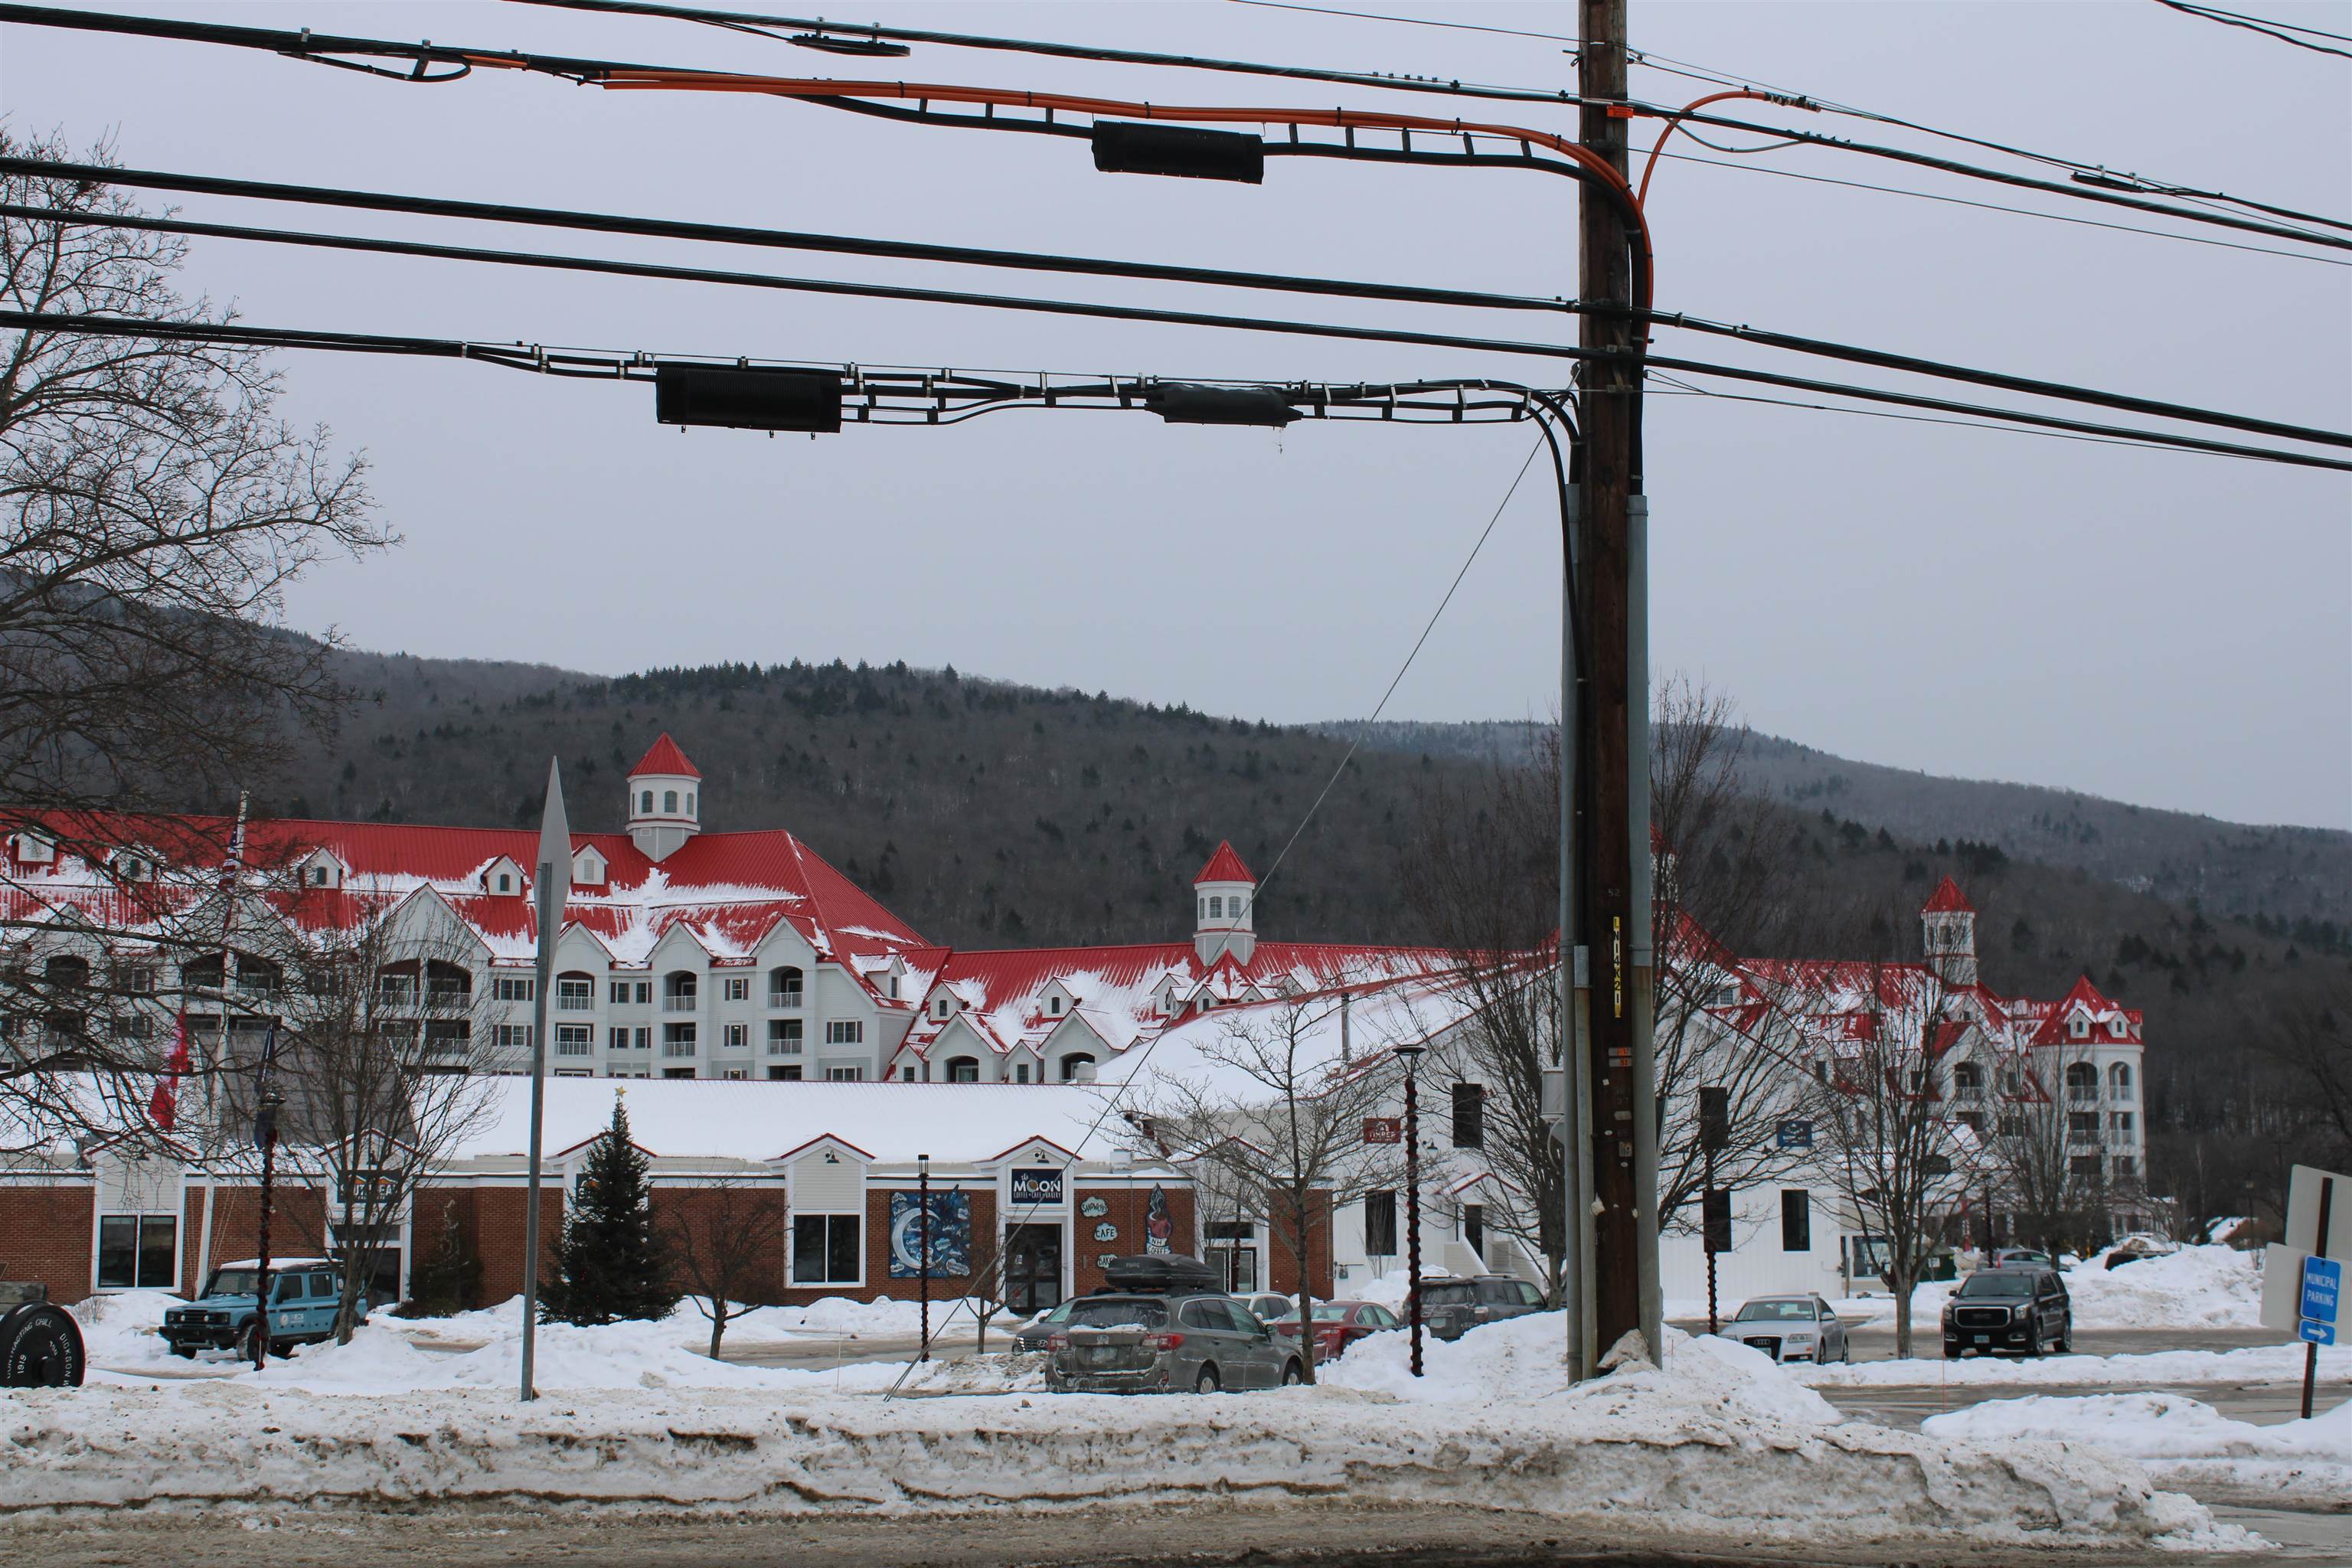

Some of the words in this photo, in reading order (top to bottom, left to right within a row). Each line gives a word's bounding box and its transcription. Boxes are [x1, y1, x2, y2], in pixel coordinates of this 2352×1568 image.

[1014, 1180, 1061, 1192] MOON
[1096, 1228, 1115, 1237] CAFE
[2306, 1272, 2337, 1290] MUNICIPAL
[2307, 1289, 2334, 1306] PARKING
[17, 1354, 27, 1374] 1919
